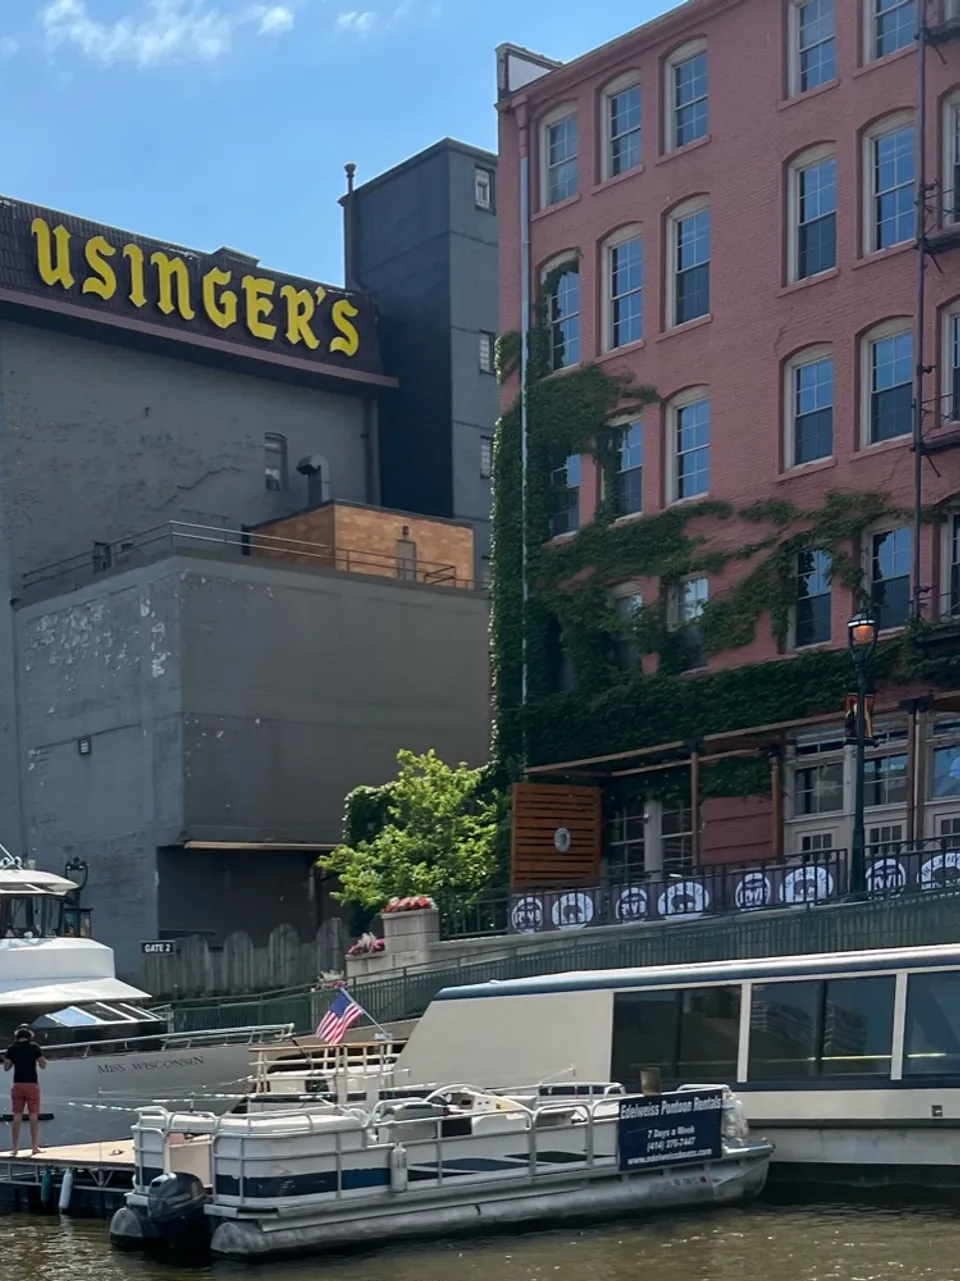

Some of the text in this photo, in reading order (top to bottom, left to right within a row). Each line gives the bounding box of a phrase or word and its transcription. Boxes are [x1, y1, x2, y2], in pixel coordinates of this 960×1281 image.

[31, 217, 360, 356] USINGER'S
[144, 943, 171, 953] GATE 2
[97, 1055, 204, 1075] MISS WISCONSIN
[620, 1096, 722, 1120] Edelweiss Pontoon Rentals
[647, 1130, 653, 1138] 7
[653, 1128, 670, 1139] Days
[646, 1141, 664, 1152] (414)
